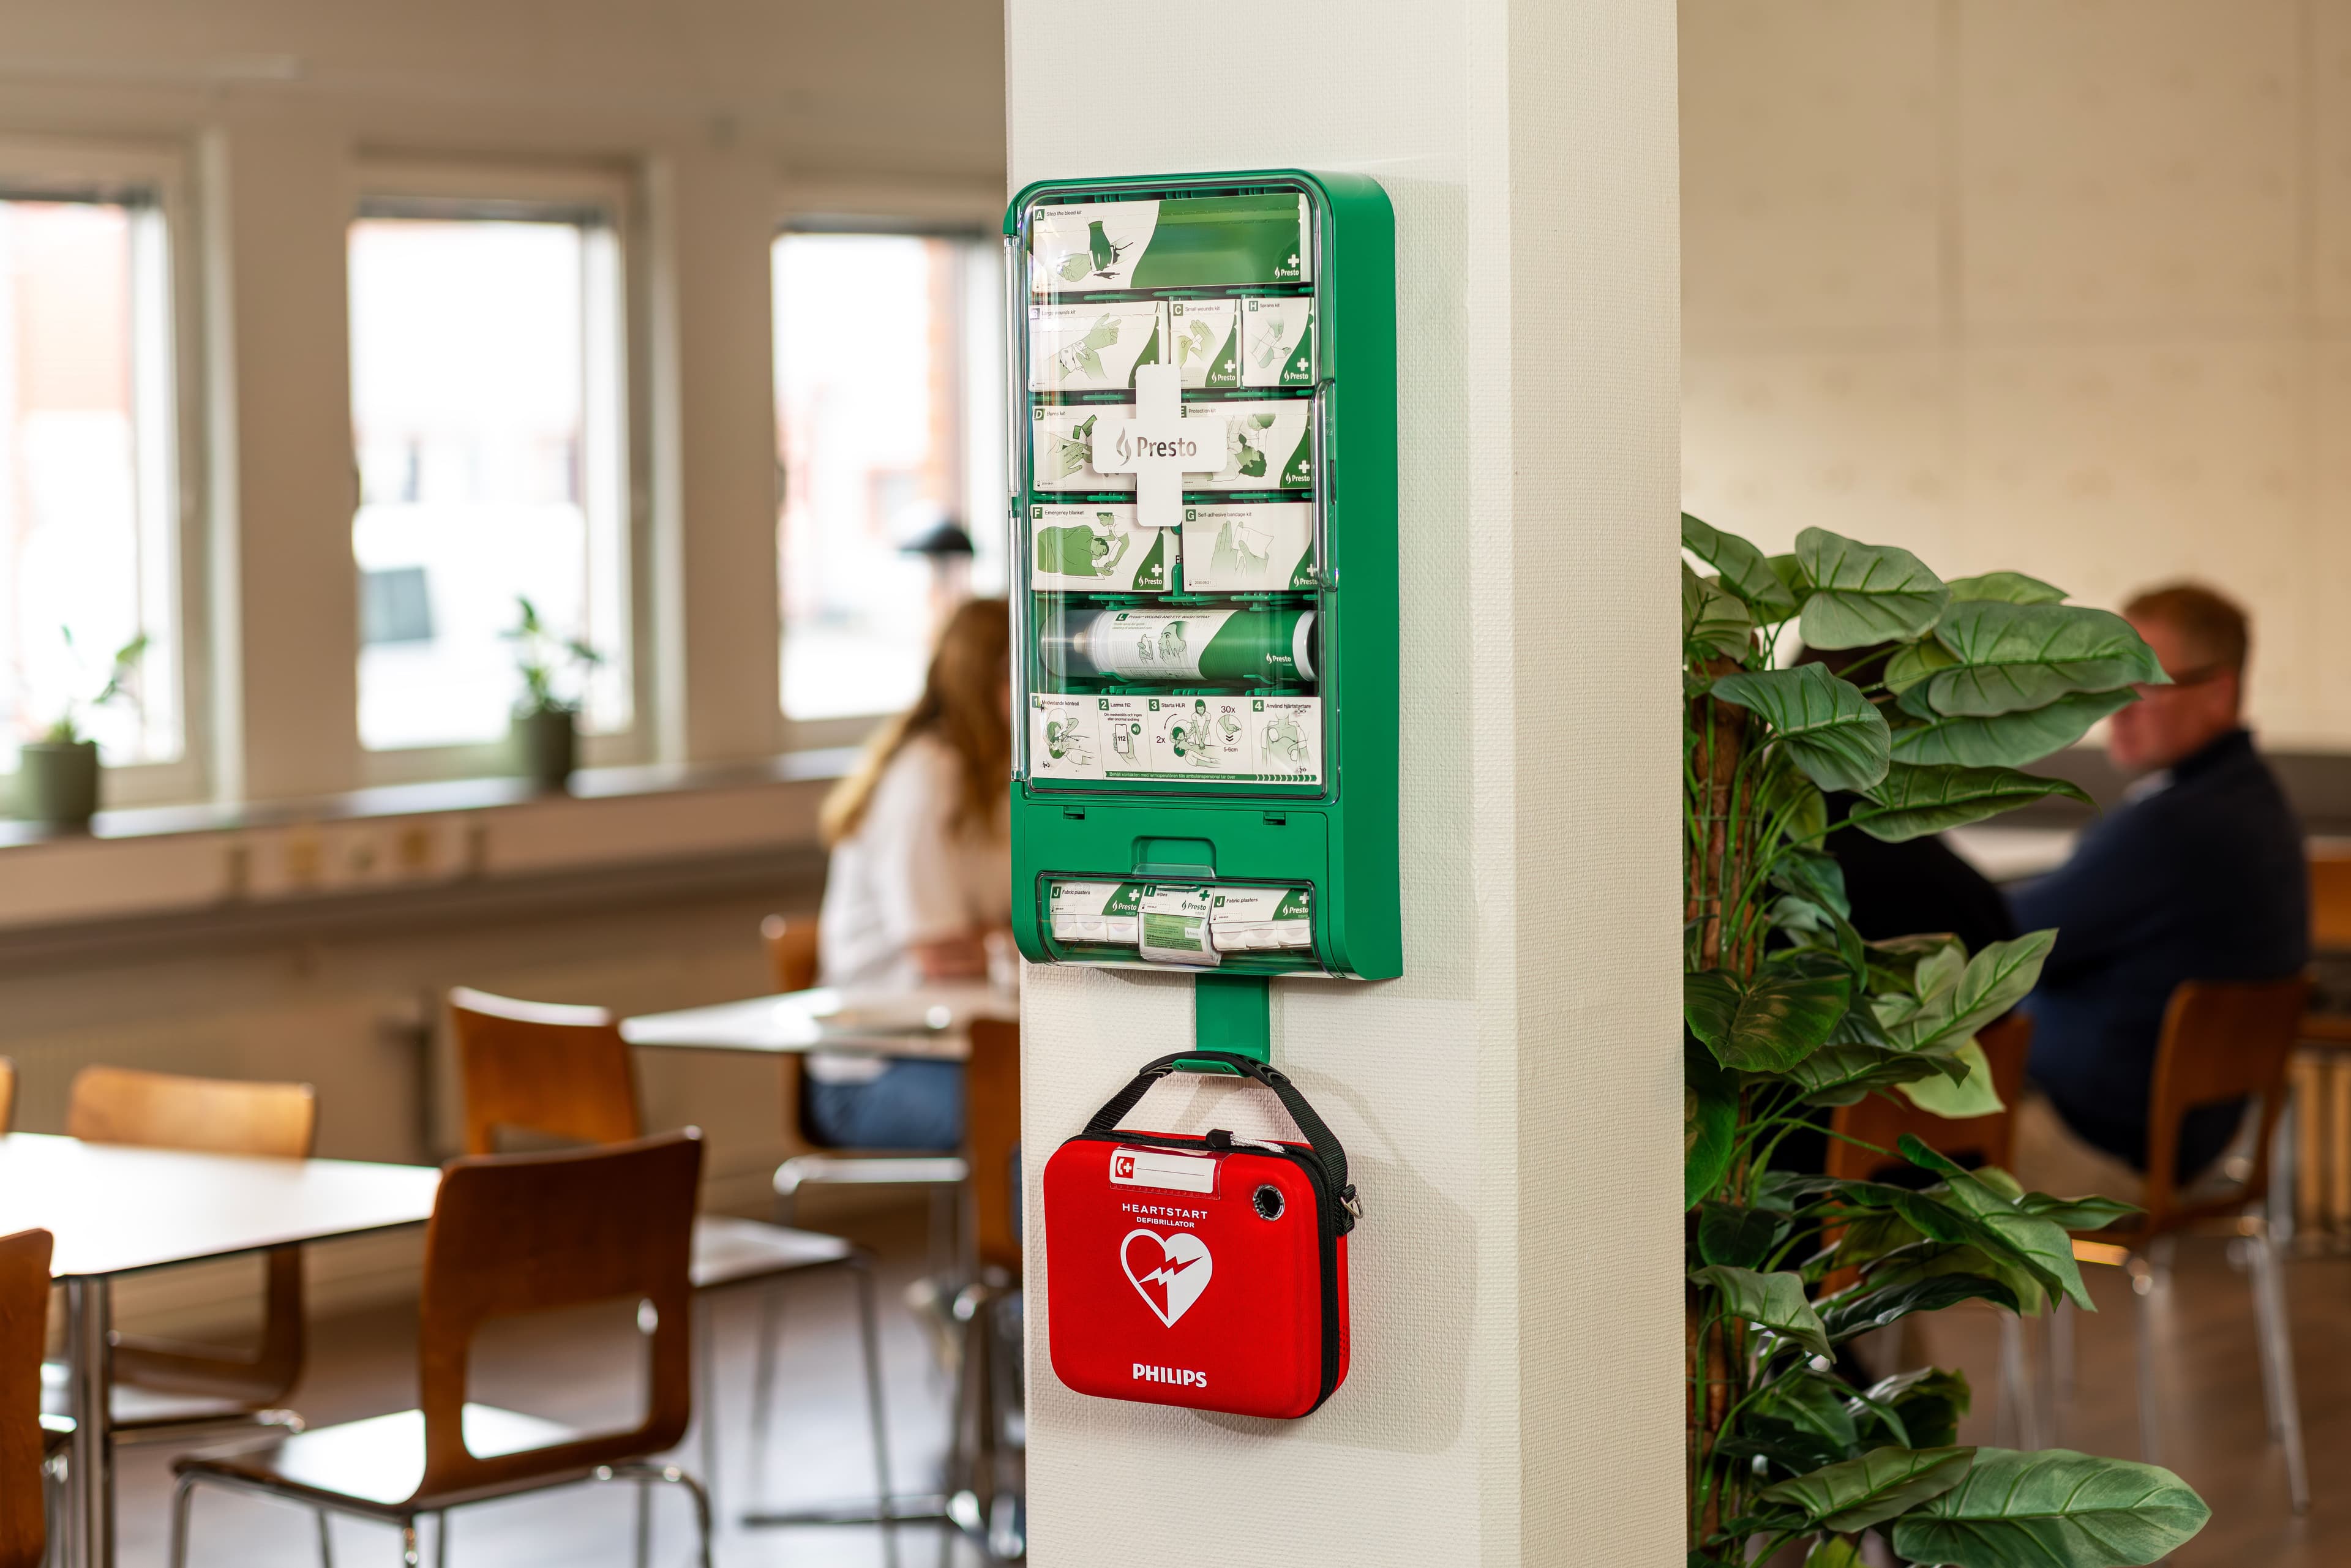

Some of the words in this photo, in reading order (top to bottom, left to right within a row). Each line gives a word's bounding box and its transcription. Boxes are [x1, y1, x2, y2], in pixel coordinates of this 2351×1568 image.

[1037, 211, 1043, 219] A
[1174, 306, 1182, 314] C
[1250, 302, 1257, 310] H
[1137, 437, 1197, 457] Presto
[1035, 509, 1040, 517] F
[1188, 511, 1194, 520] G
[1101, 700, 1107, 709] 2
[1151, 701, 1157, 710] 3
[1255, 702, 1262, 710] 4
[1054, 888, 1059, 896] J
[1217, 898, 1222, 906] J
[1122, 1203, 1207, 1219] HEARTSTART
[1136, 1217, 1194, 1228] DEFIBRILLATOR
[1133, 1363, 1207, 1388] PHILIPS
